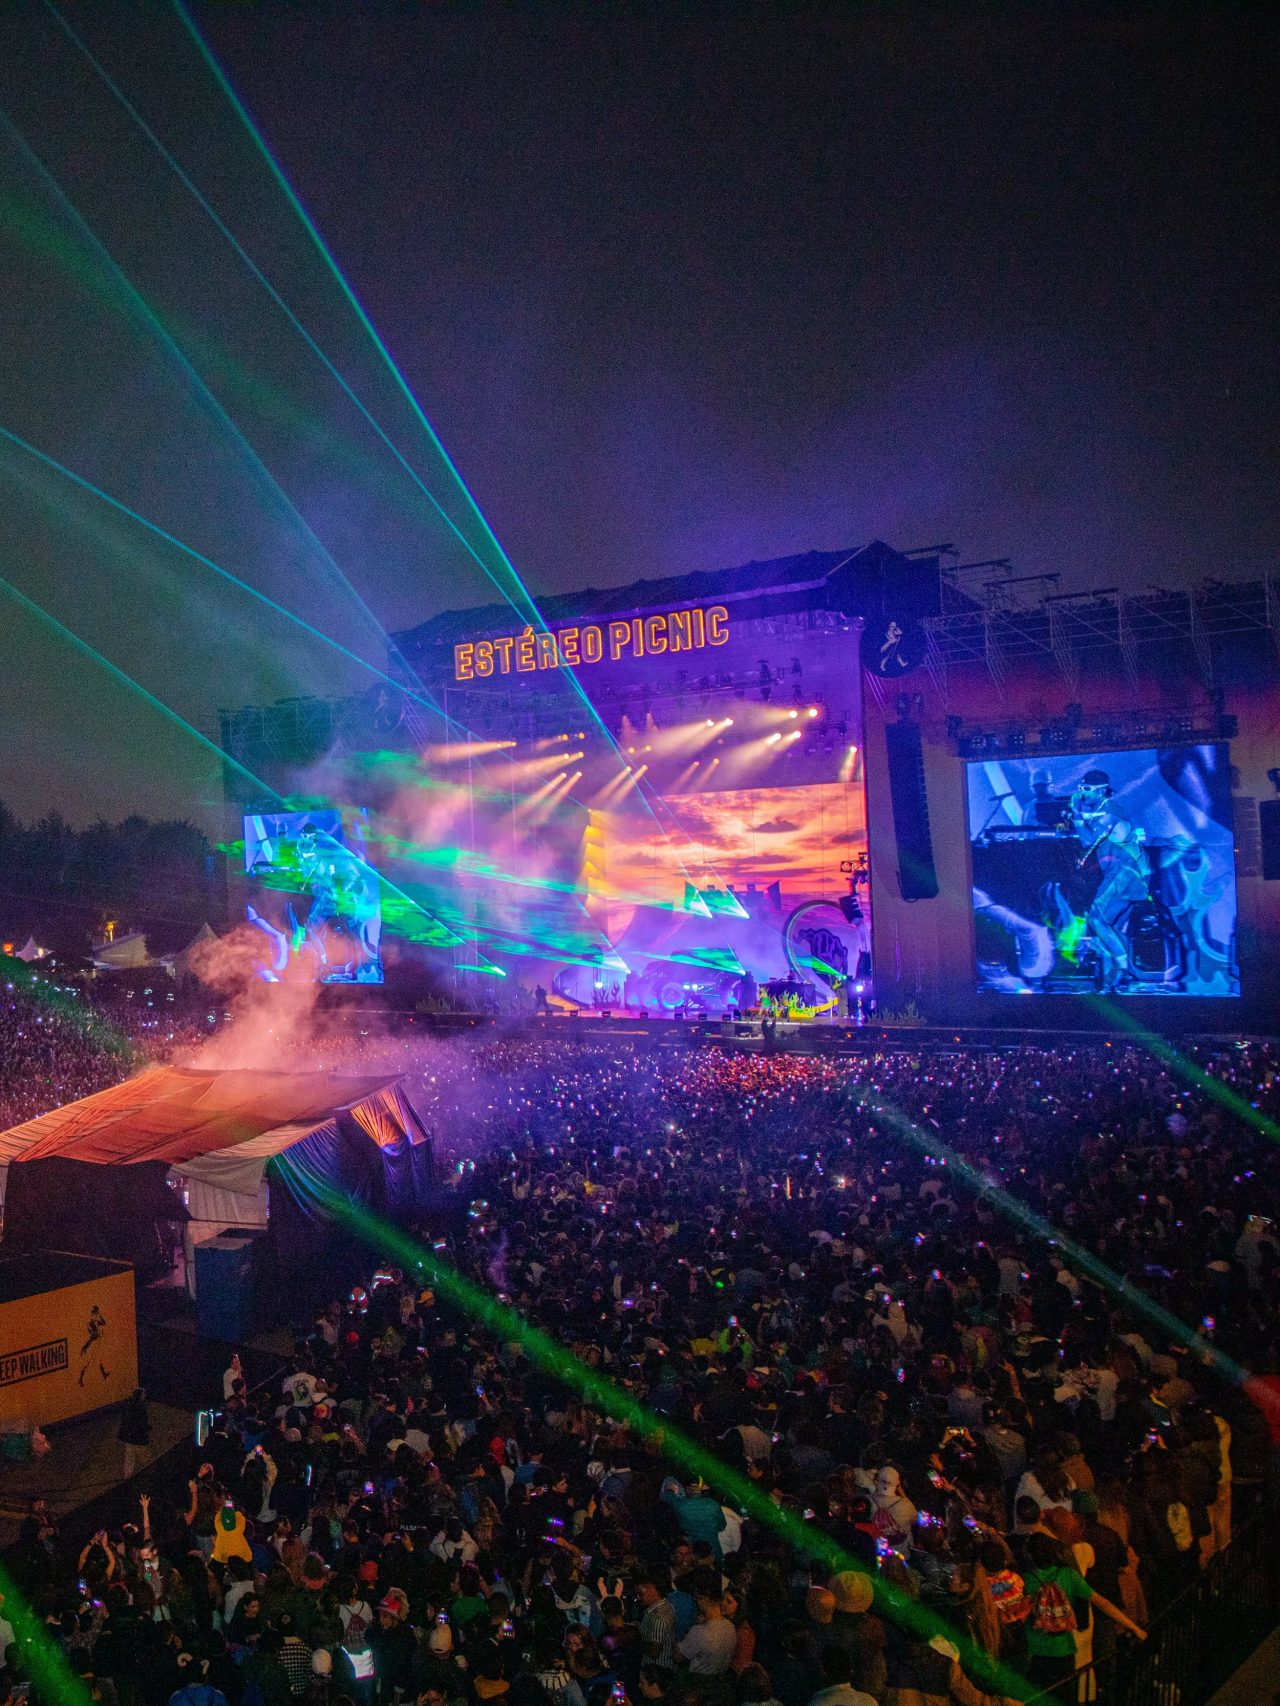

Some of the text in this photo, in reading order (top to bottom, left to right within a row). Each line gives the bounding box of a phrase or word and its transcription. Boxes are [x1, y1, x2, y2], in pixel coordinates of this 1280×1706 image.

[454, 606, 729, 681] ESTÉREO PICNIC
[19, 1345, 65, 1375] WALKING
